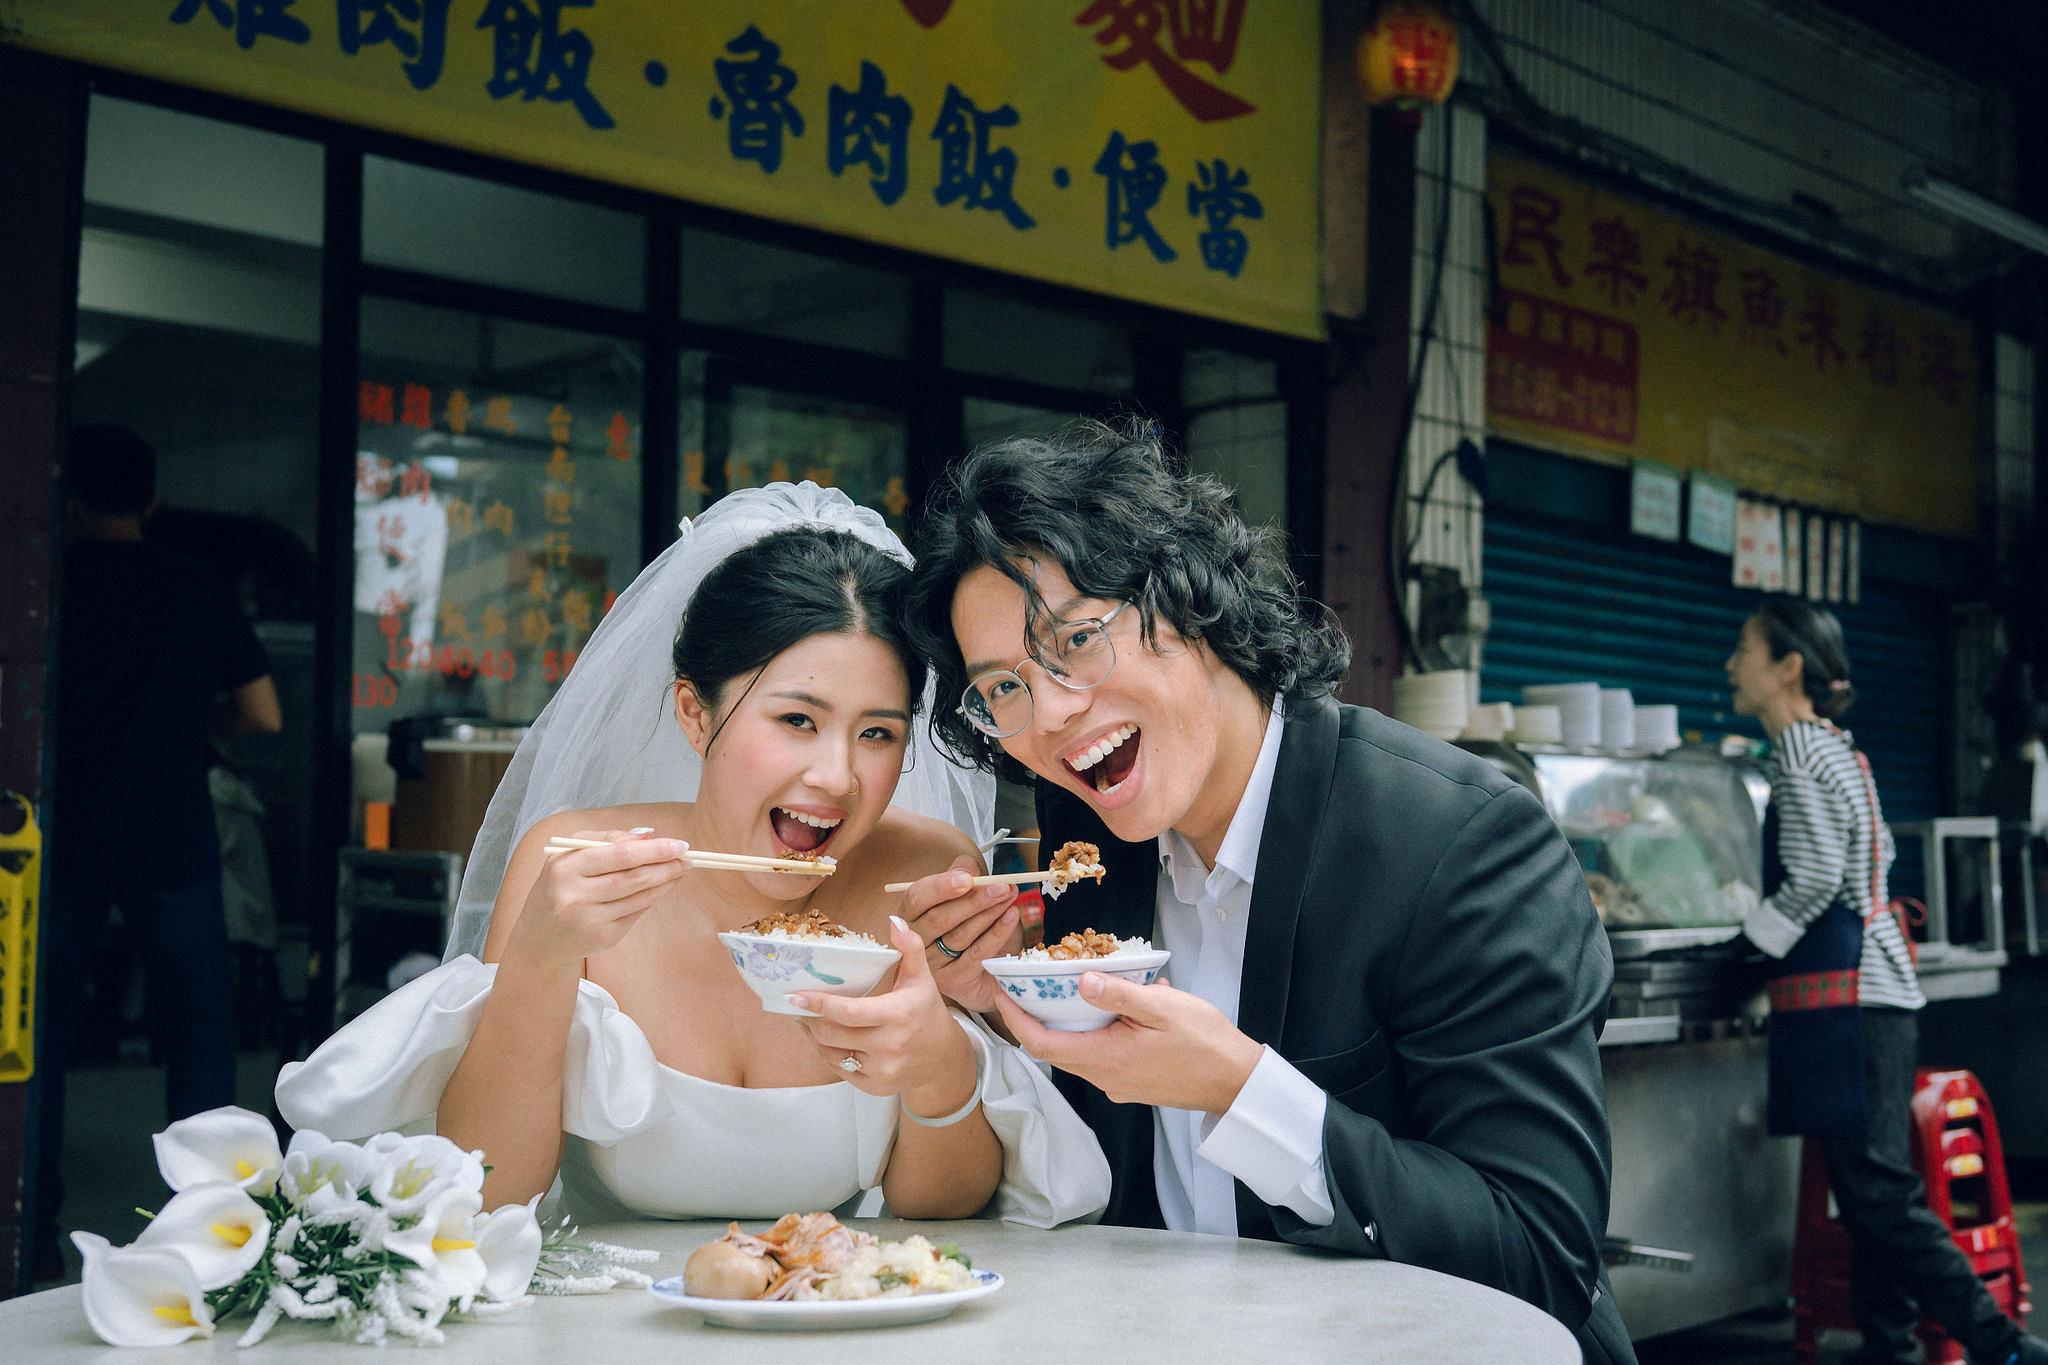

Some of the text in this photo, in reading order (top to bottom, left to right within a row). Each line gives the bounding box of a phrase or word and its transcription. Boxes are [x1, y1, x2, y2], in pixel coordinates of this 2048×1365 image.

[436, 644, 475, 680] 40
[478, 648, 516, 683] 40
[351, 673, 398, 708] 130
